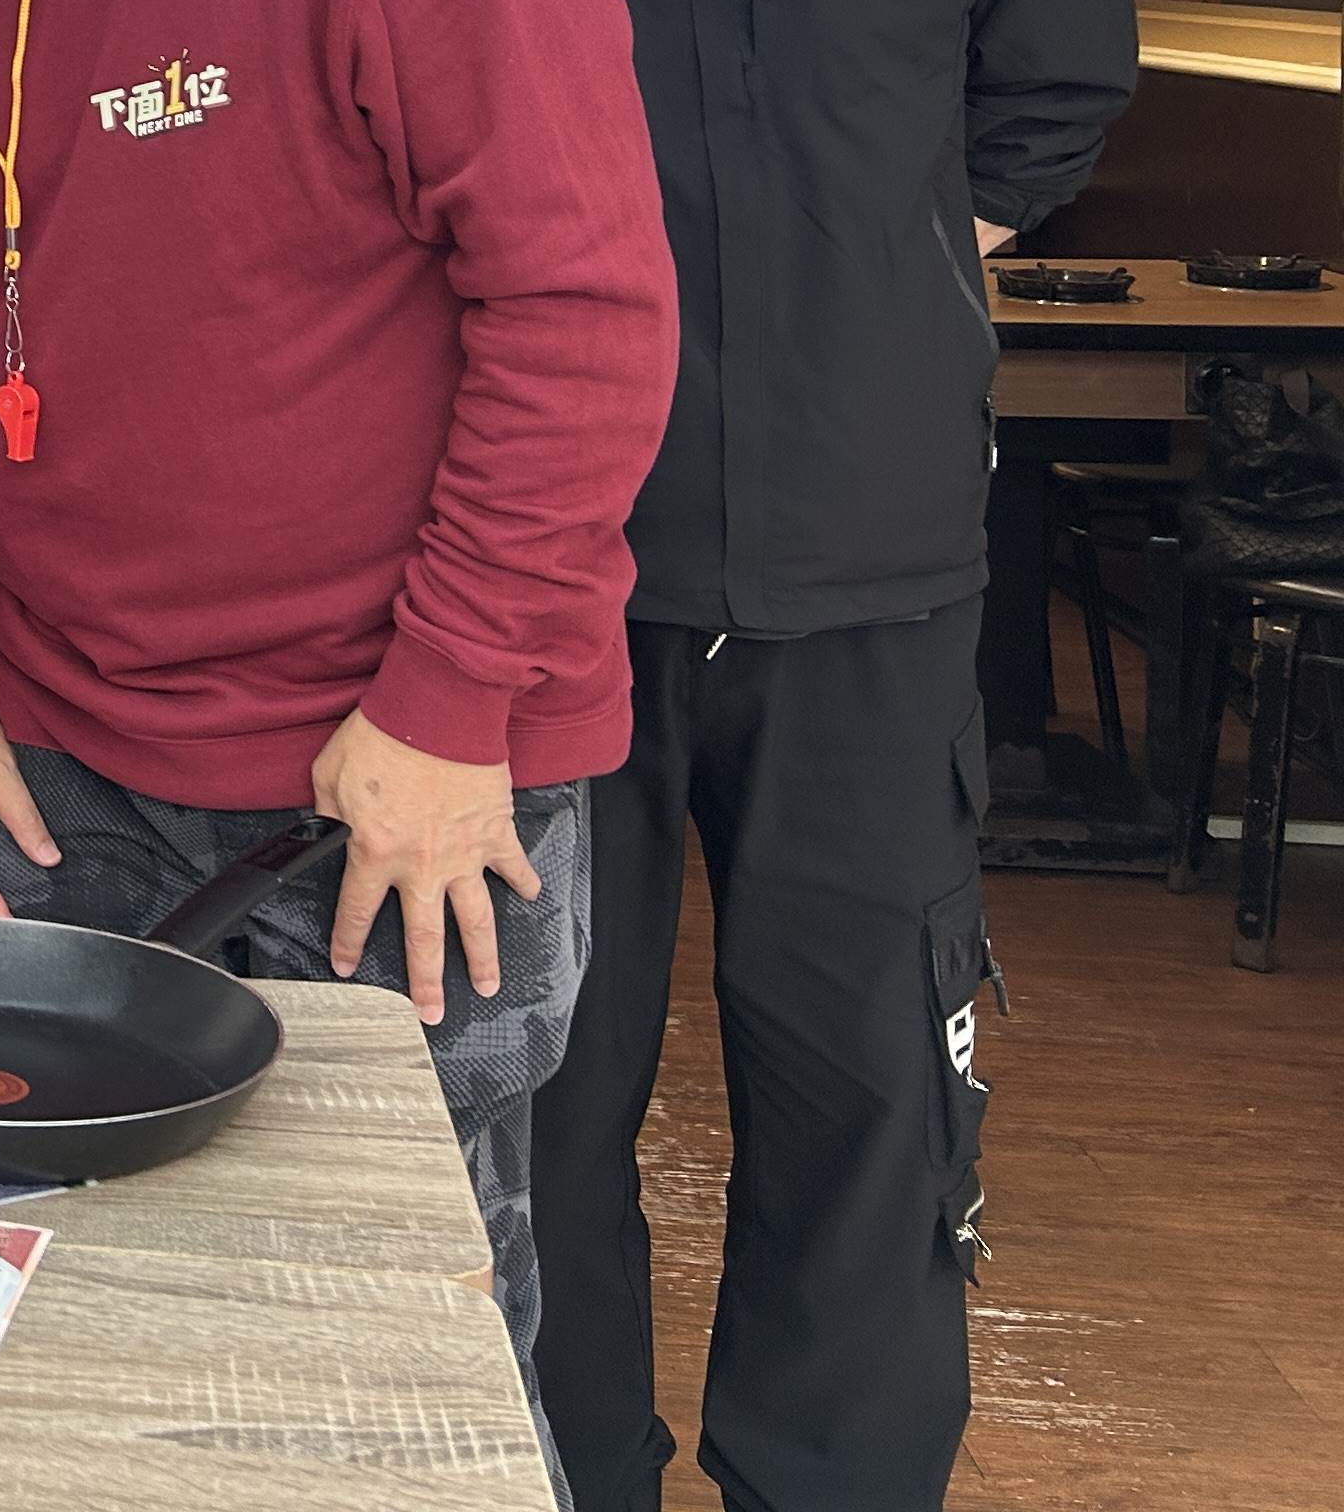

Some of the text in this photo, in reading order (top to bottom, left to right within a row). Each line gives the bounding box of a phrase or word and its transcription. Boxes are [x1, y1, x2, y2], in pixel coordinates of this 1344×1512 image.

[90, 59, 231, 133] 下面1位
[137, 109, 204, 137] NEXT ONE
